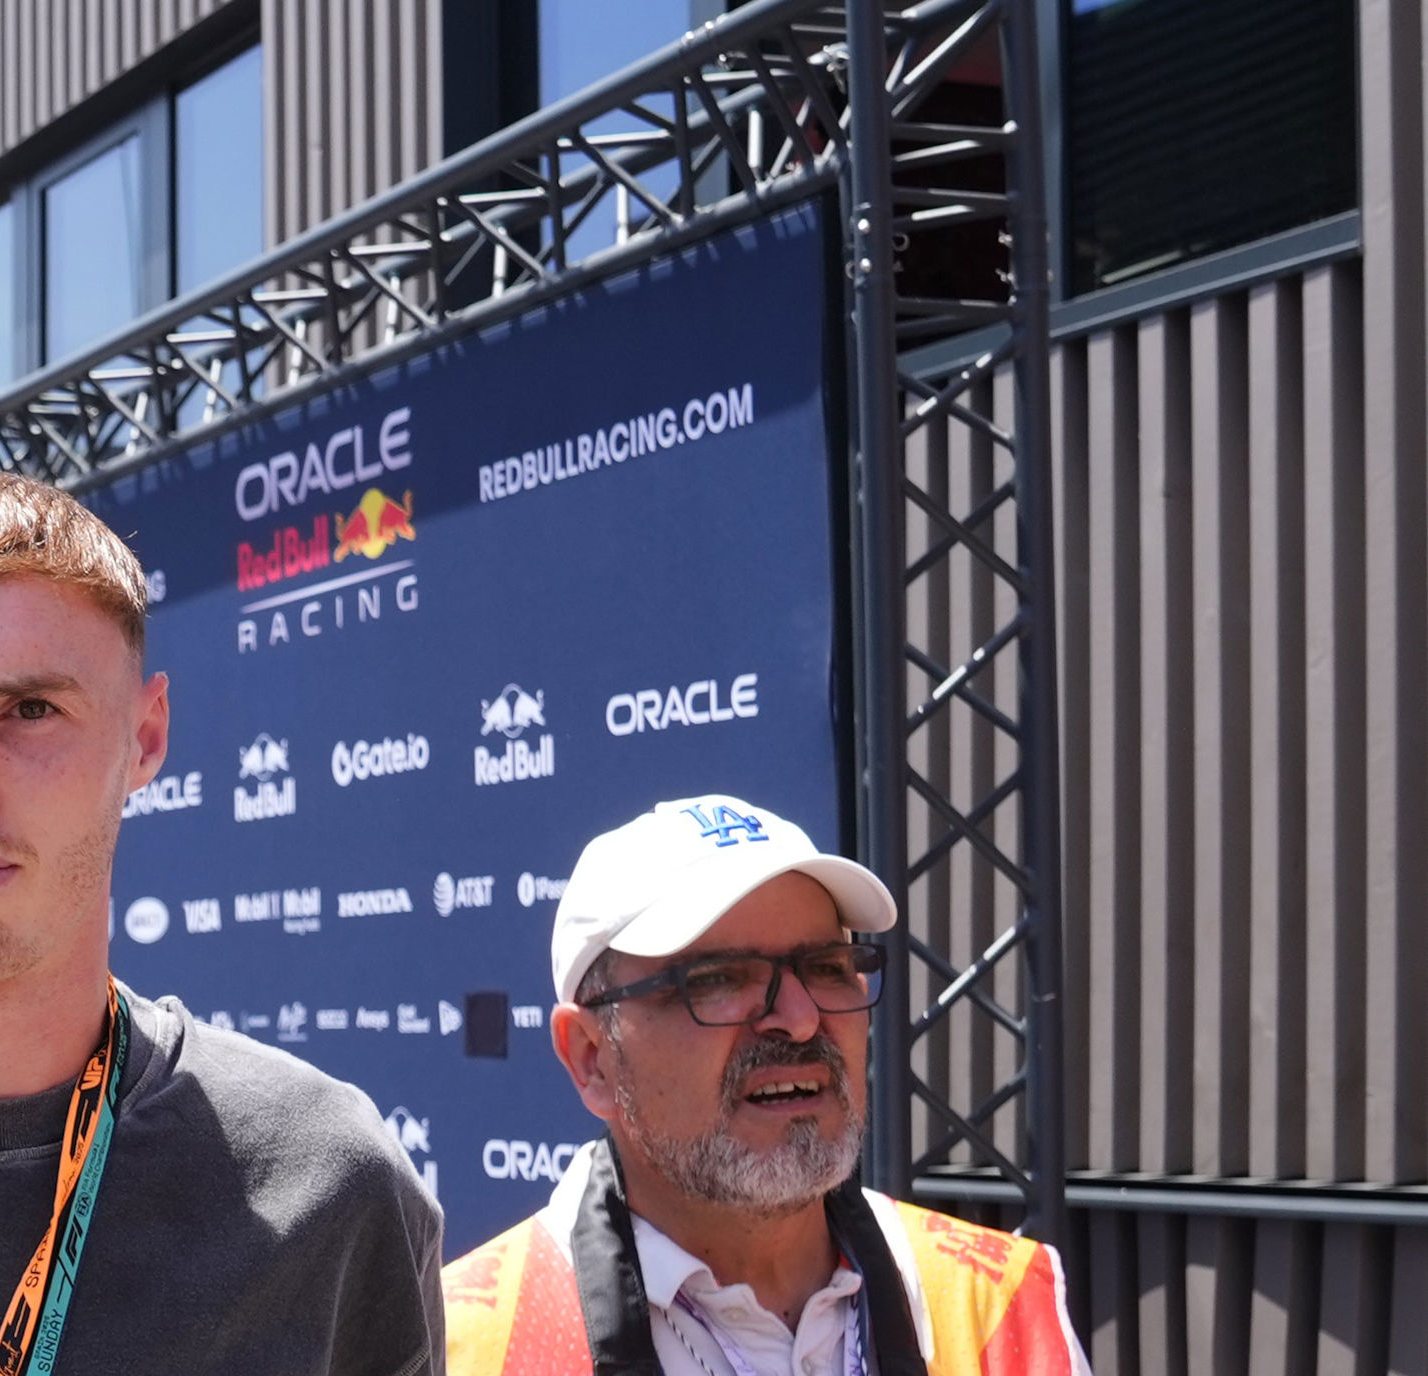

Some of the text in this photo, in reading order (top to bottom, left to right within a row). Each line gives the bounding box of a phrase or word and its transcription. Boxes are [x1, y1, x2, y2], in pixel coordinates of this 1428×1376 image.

[236, 406, 412, 521] ORACLE
[478, 383, 753, 503] REDBULLRACING.COM
[238, 574, 419, 654] RACING
[606, 673, 758, 736] ORACLE
[352, 732, 430, 780] Gate.io
[679, 803, 770, 848] LA
[338, 888, 413, 918] HONDA
[454, 875, 495, 908] AT&T
[182, 898, 222, 934] VISA
[511, 1005, 543, 1028] YETI
[80, 1056, 104, 1090] VIP
[482, 1138, 581, 1182] ORAC
[37, 1309, 64, 1372] SUNDAY
